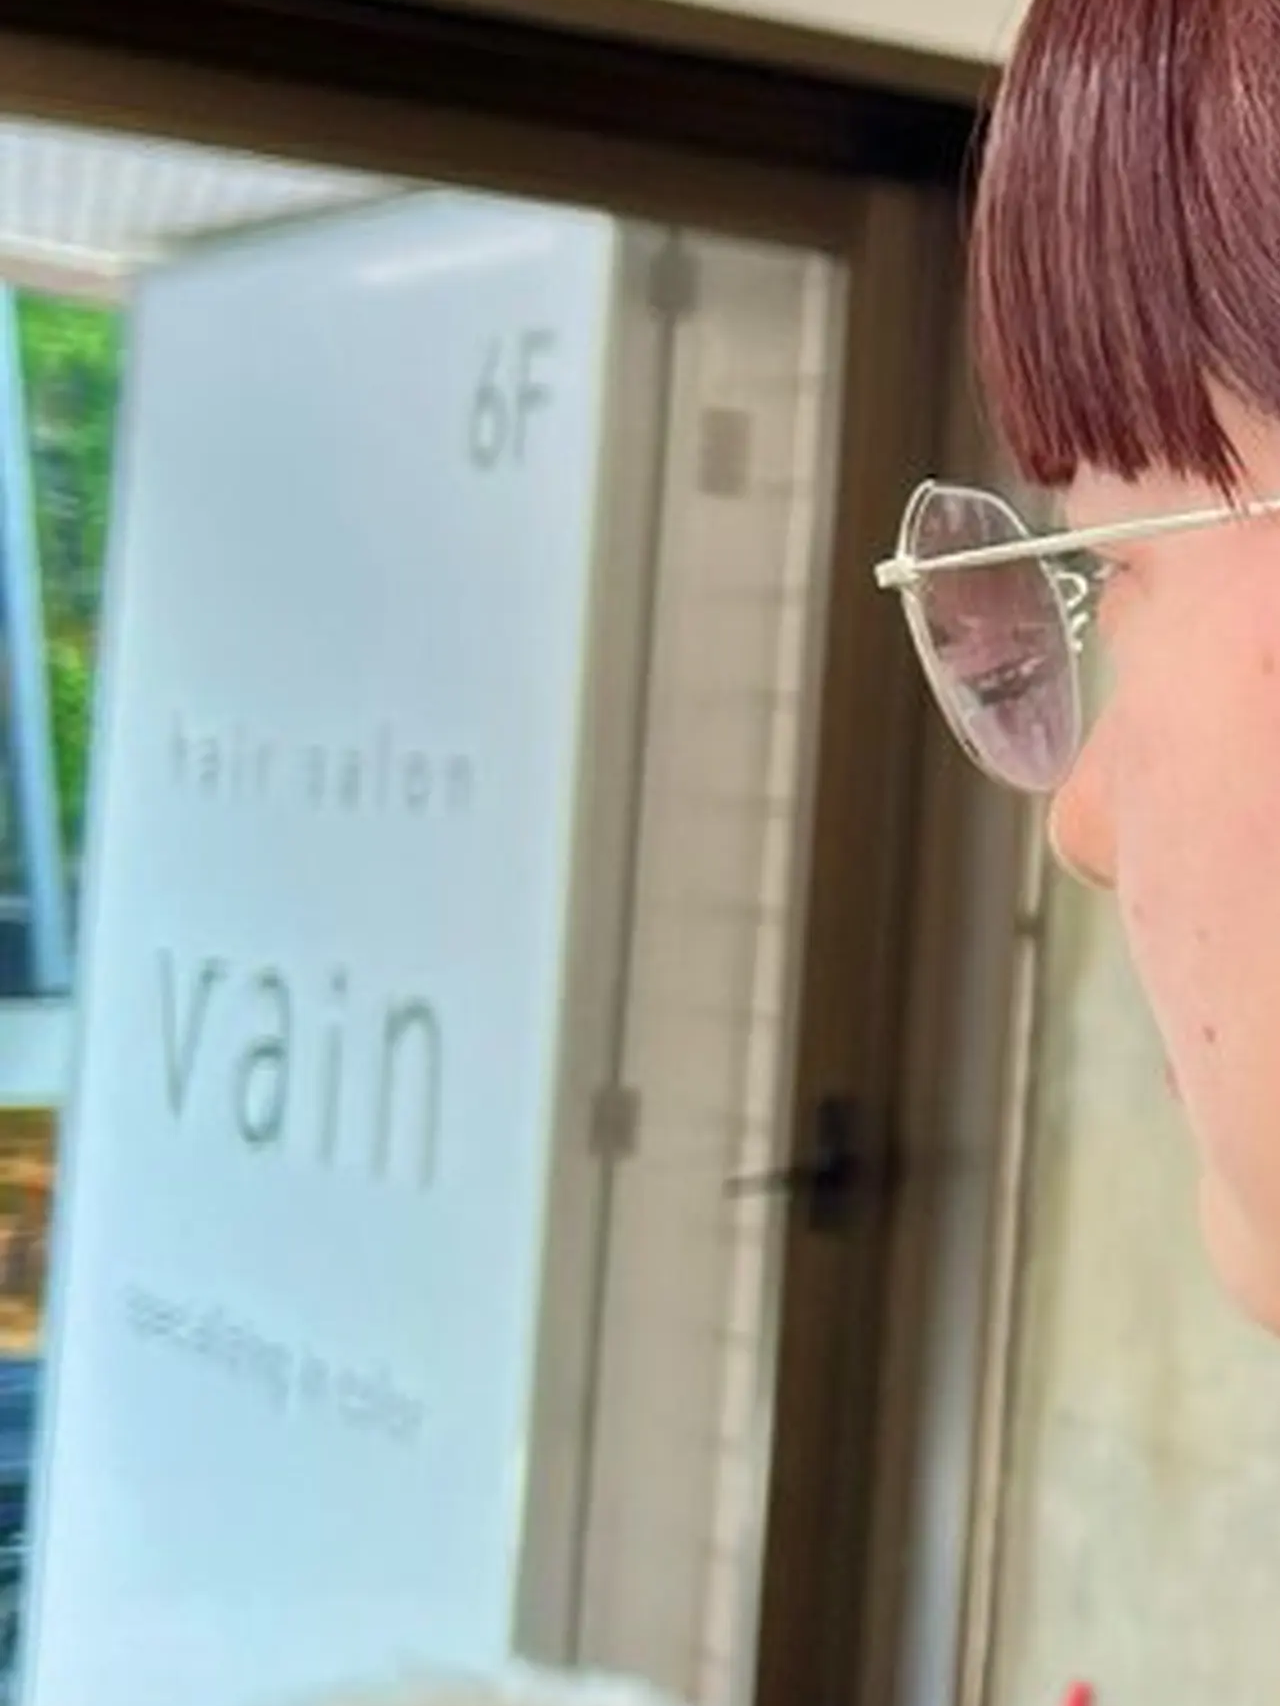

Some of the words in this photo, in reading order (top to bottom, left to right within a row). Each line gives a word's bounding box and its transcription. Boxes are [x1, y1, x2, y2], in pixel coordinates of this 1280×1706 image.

[468, 327, 558, 472] 6F
[300, 719, 474, 816] salon
[157, 946, 443, 1193] vain
